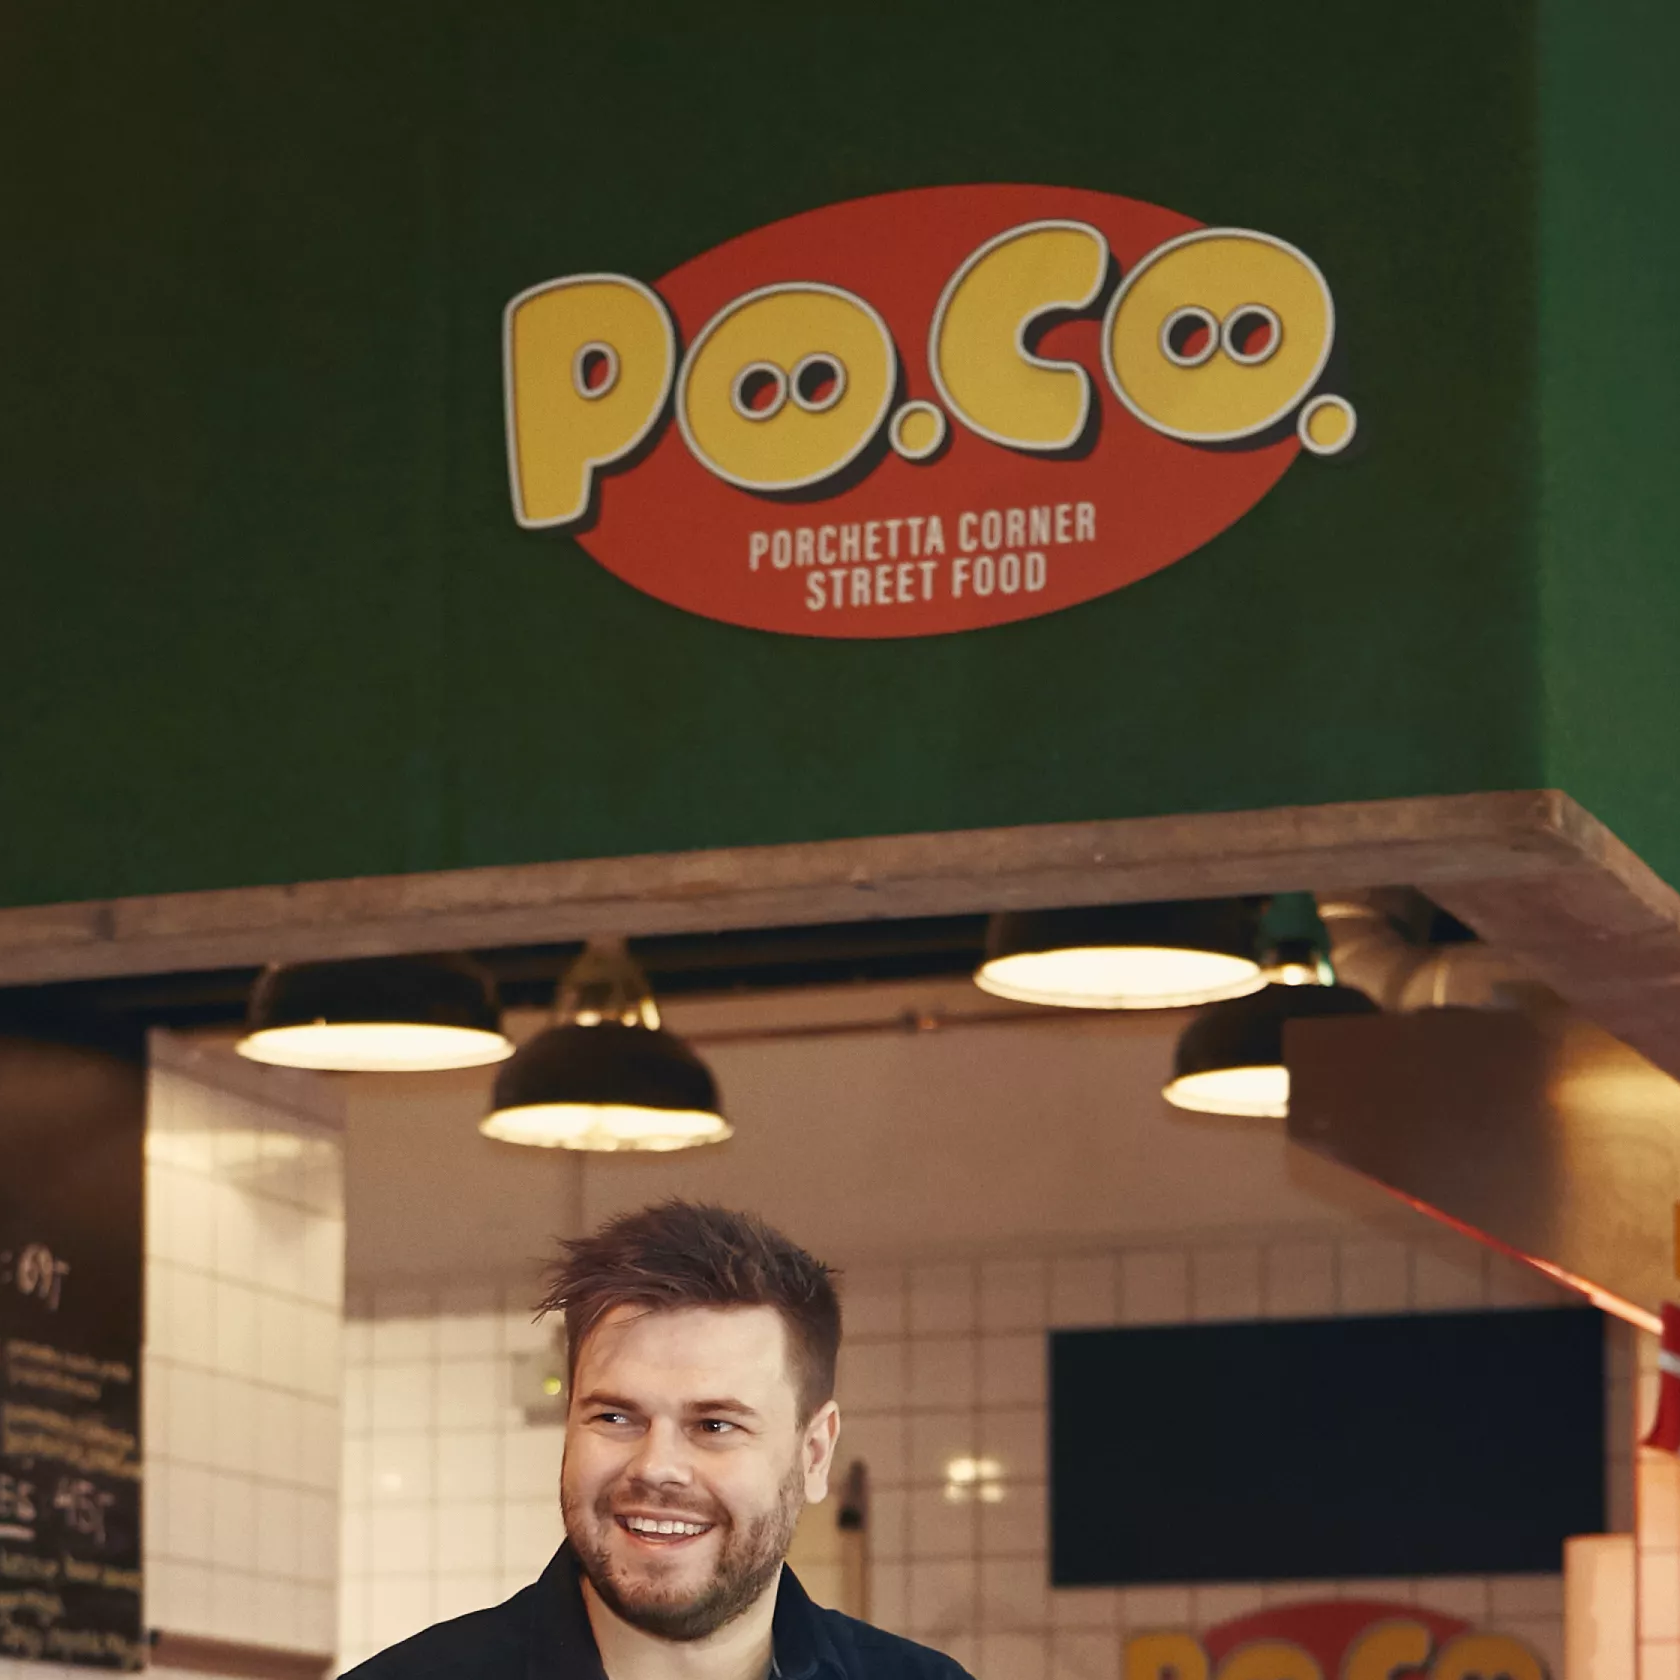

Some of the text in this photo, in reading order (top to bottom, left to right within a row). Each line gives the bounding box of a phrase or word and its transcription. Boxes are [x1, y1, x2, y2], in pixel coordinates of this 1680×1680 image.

[748, 503, 1097, 571] PORCHETTA CORNER
[805, 552, 1048, 611] STREET FOOD
